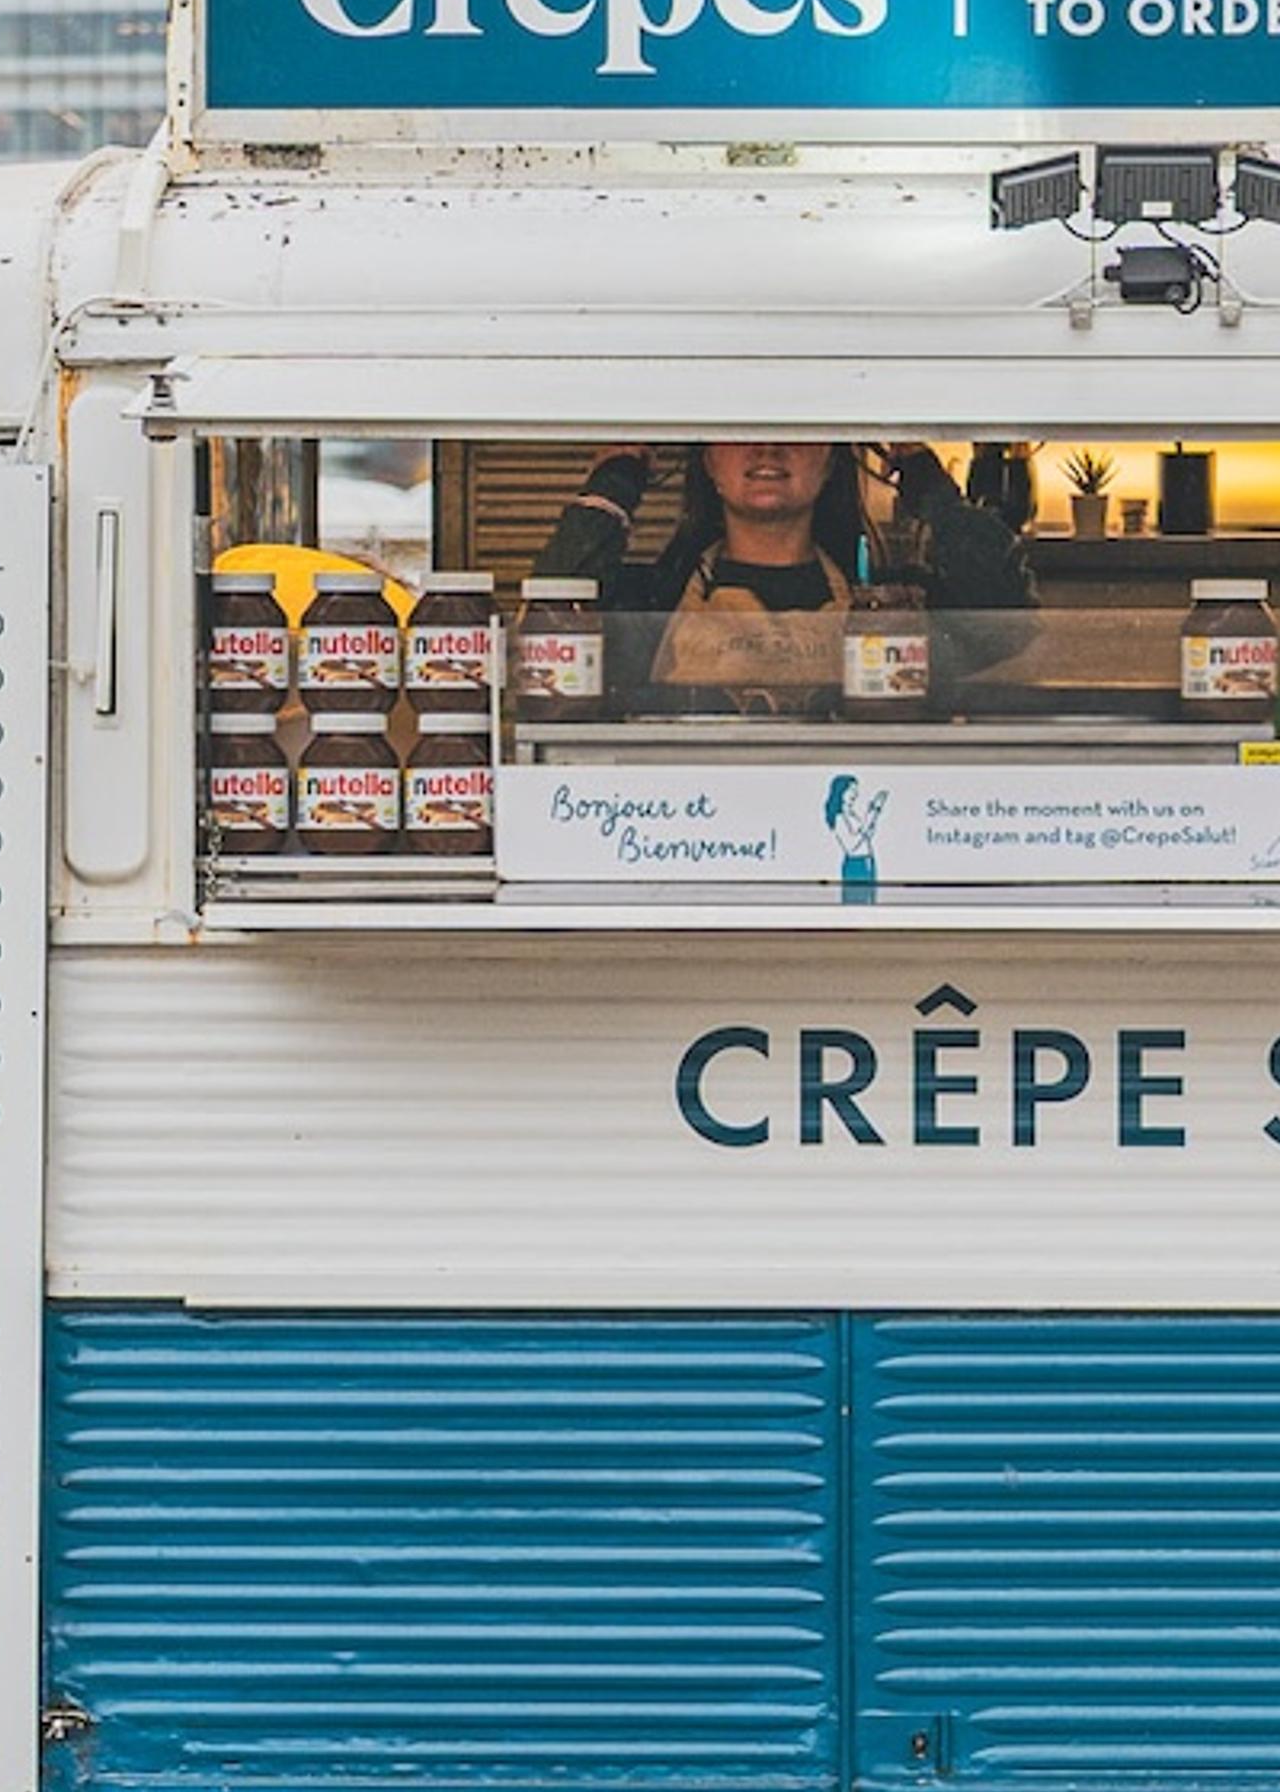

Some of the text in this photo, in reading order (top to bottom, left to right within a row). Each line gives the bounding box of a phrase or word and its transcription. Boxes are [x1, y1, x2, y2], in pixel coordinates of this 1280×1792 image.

[212, 631, 284, 656] utella
[309, 631, 395, 656] nutella
[1210, 643, 1278, 665] nutell
[213, 772, 284, 796] utella
[307, 772, 394, 796] nutella
[550, 784, 715, 836] Bonjour et
[927, 799, 1204, 817] Share the moment with us on
[616, 829, 779, 863] Bienvenue!
[927, 826, 1236, 848] Instagram and tag @CrepeSalut!
[676, 983, 1185, 1147] CRÊPE
